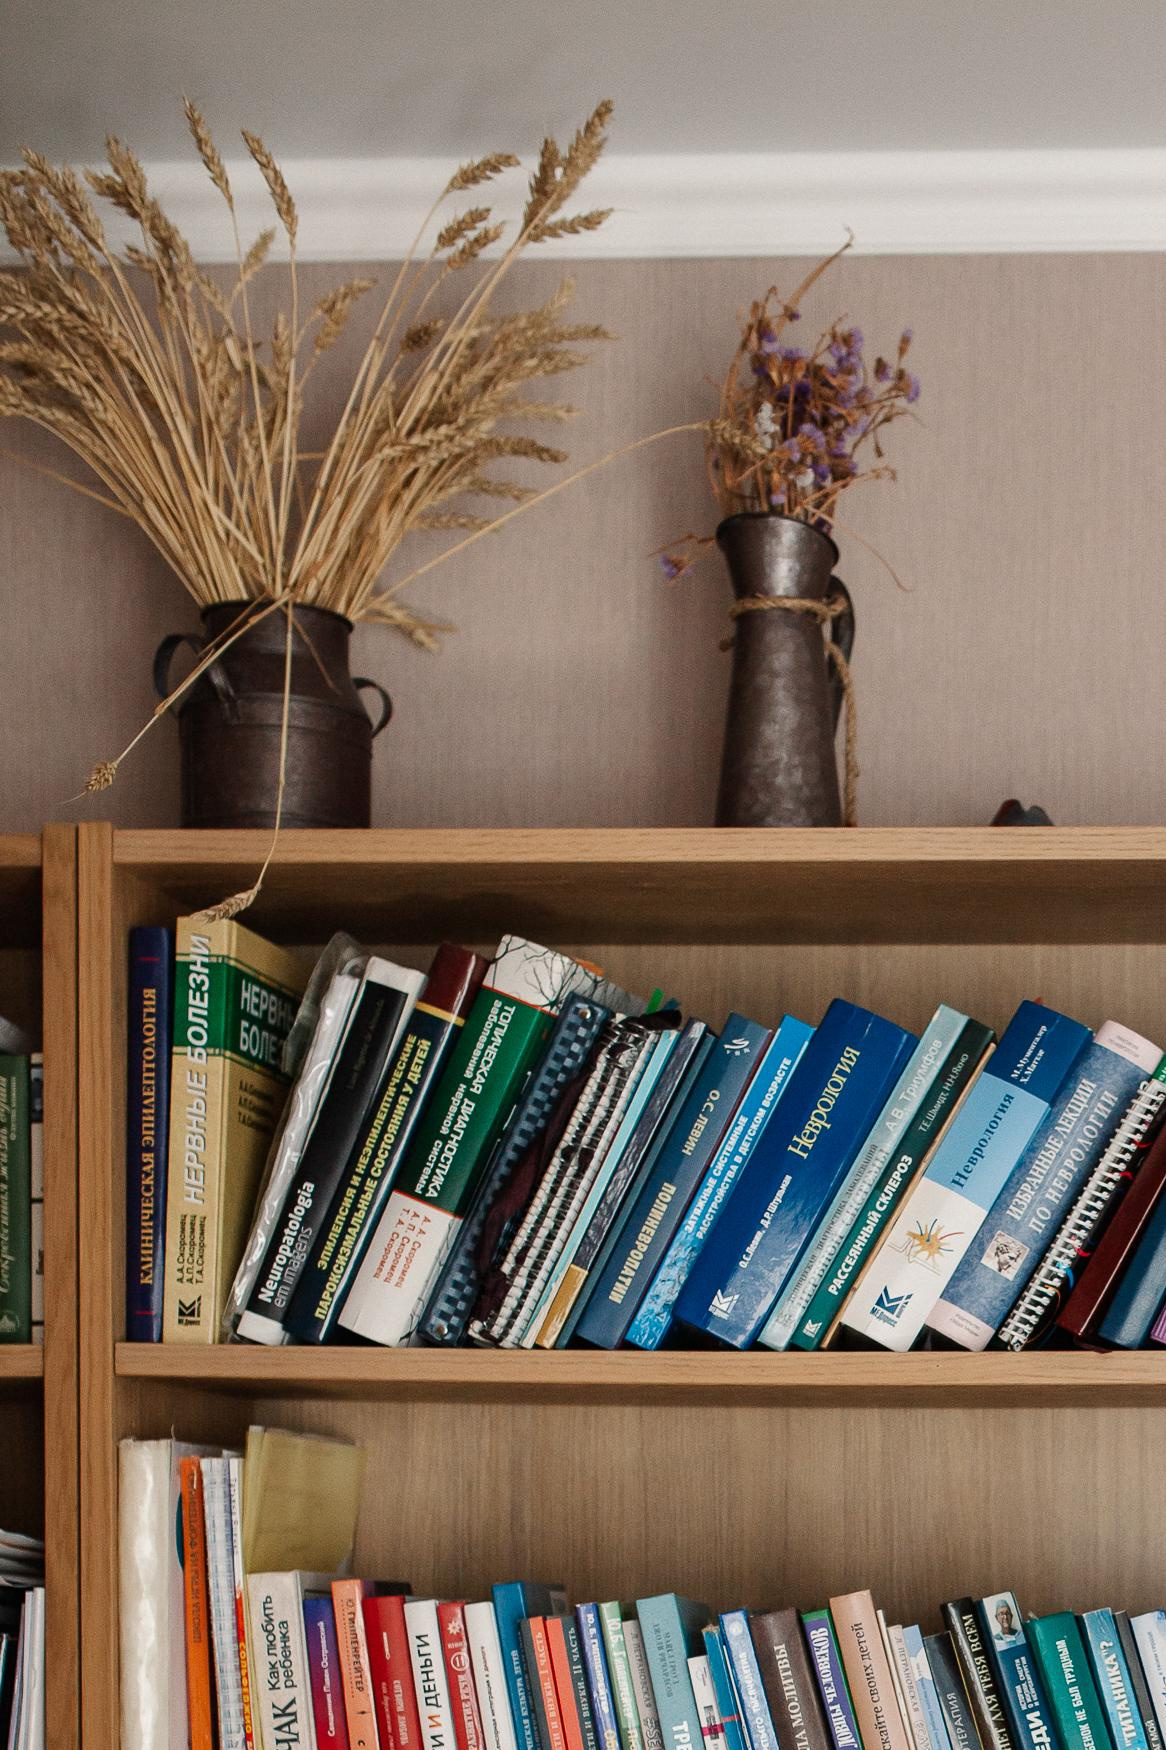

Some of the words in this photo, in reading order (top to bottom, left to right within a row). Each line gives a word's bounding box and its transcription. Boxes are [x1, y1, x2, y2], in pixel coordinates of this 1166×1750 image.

[186, 934, 211, 1064] БОЛЕЗНИ
[463, 999, 502, 1078] заболеваний
[141, 988, 157, 1147] ЭПИЛЕПТОЛОГИЯ
[469, 1005, 515, 1094] ТОПИЧЕСКАЯ
[184, 1071, 208, 1204] НЕРВНЫЕ
[352, 1034, 418, 1172] НЕЭПИЛЕПТИЧЕСКИЕ
[439, 1083, 466, 1135] нервной
[787, 1046, 861, 1159] Неврология
[951, 1092, 1015, 1189] Неврология
[314, 1179, 384, 1319] ПАРОКСИЗМАЛЬНЫЕ
[368, 1095, 412, 1177] СОСТОЯНИЯ
[408, 1039, 432, 1083] ДЕТЕЙ
[347, 1176, 362, 1186] И
[413, 1140, 443, 1194] системы
[425, 1098, 475, 1199] ДИАГНОСТИКА
[684, 1178, 719, 1233] ЗАТЯЖНЫЕ
[710, 1115, 749, 1176] СИСТЕМНЫЕ
[696, 1166, 741, 1239] РАССТРОЙСТВА
[736, 1109, 766, 1153] ДЕТСКОМ
[756, 1056, 792, 1107] ВОЗРАСТЕ
[1006, 1135, 1064, 1221] ИЗБРАННЫЕ
[1047, 1079, 1099, 1136] ЛЕКЦИИ
[1030, 1207, 1052, 1233] ПО
[1042, 1090, 1119, 1203] НЕВРОЛОГИИ
[140, 1152, 156, 1285] КЛИНИЧЕСКАЯ
[258, 1181, 315, 1302] Neuropatologia
[280, 1226, 313, 1283] imagens
[317, 1189, 358, 1269] ЭПИЛЕПСИЯ
[609, 1182, 676, 1304] ПОЛИНЕВРОПАТИИ
[828, 1212, 881, 1295] РАССЕЯННЫЙ
[874, 1154, 913, 1211] СКЛЕРОЗ
[275, 1286, 290, 1308] em
[261, 1596, 278, 1658] любить
[277, 1620, 298, 1688] ребенка
[810, 1627, 838, 1702] ЧЕЛОВЕКОВ
[852, 1622, 872, 1660] детей
[1056, 1639, 1077, 1684] ТРУДНЫМ
[268, 1661, 281, 1691] Как
[415, 1633, 441, 1708] ДЕНЬГИ
[773, 1643, 804, 1726] МОЛИТВЫ
[864, 1663, 880, 1702] своих
[1069, 1686, 1084, 1706] БЫЛ
[1099, 1640, 1139, 1747] "ТИТАНИКА"?
[428, 1714, 442, 1728] И
[830, 1703, 858, 1748] ЛОВЦЫ
[1076, 1709, 1088, 1721] НЕ
